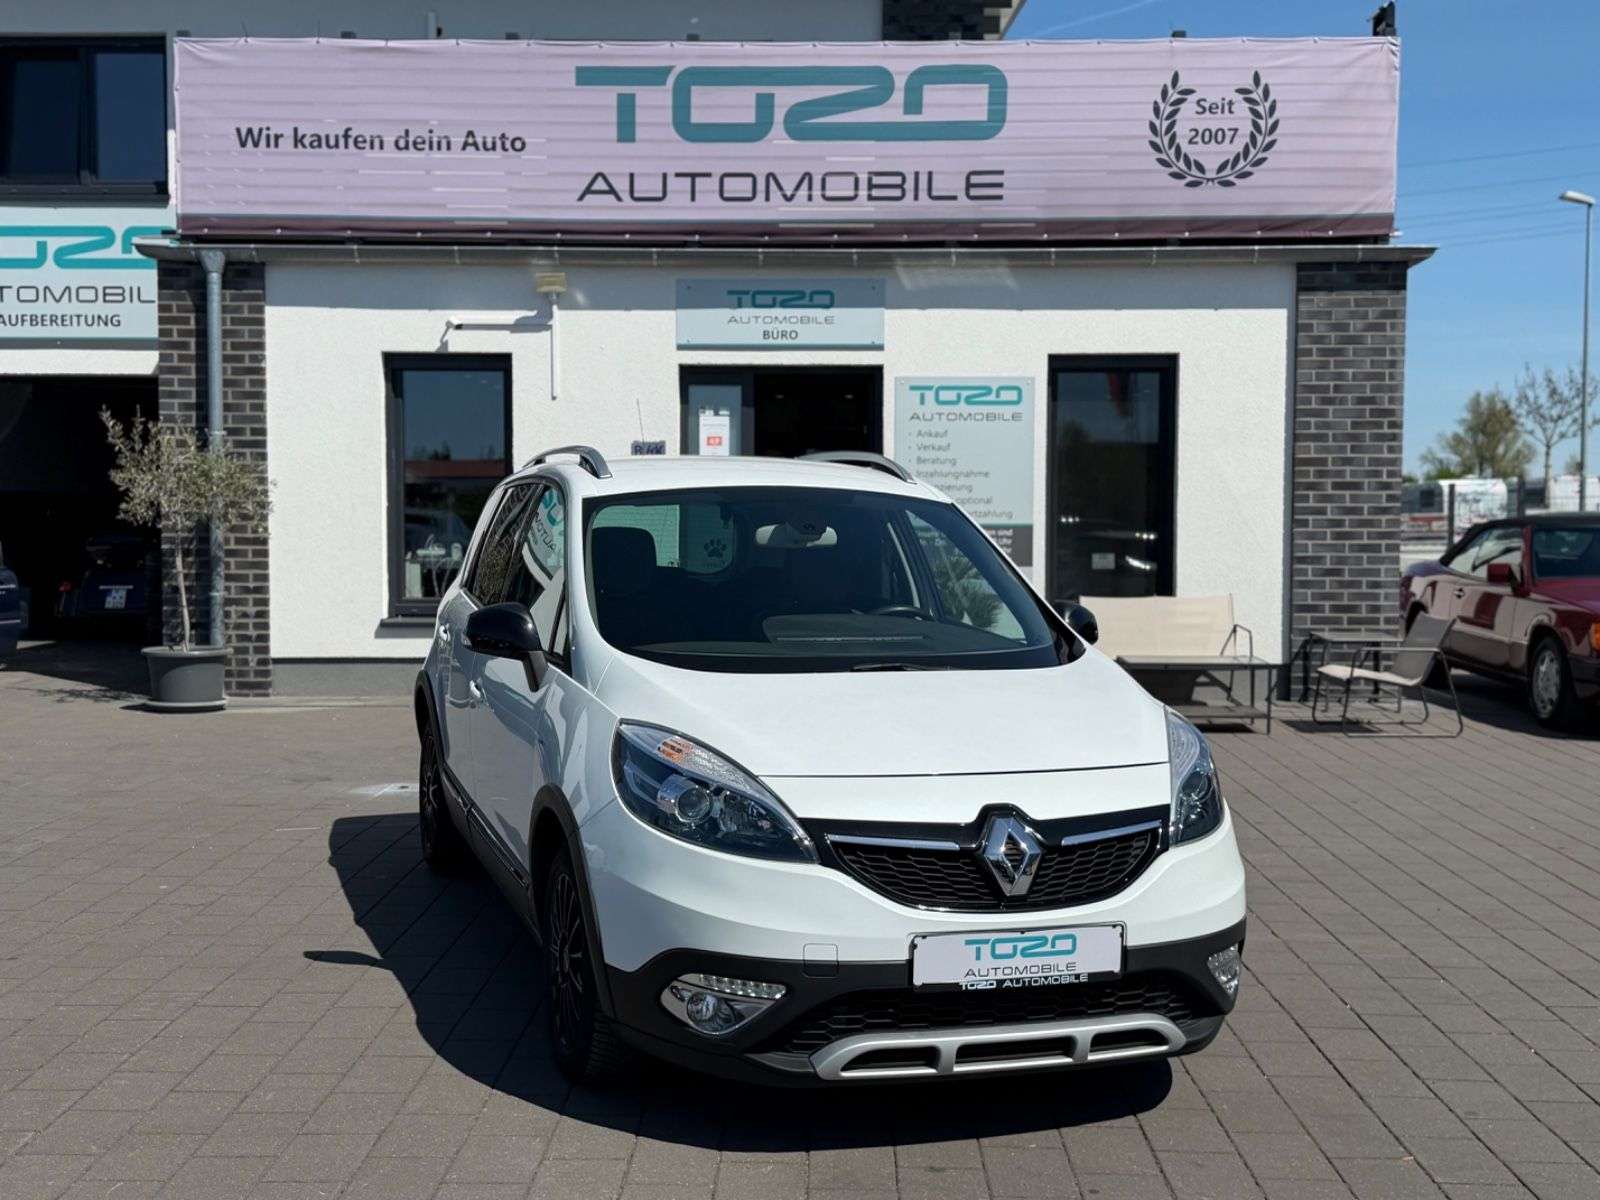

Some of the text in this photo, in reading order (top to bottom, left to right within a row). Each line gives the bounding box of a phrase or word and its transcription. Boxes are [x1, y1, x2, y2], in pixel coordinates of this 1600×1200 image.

[1195, 97, 1235, 115] Seit
[235, 126, 527, 152] Wir kaufen dein Auto
[1188, 128, 1239, 145] 2007
[577, 170, 1005, 202] AUTOMOBILE
[0, 285, 156, 304] TOMOBIL
[0, 314, 121, 327] AUFBEREITUNG
[727, 315, 835, 325] AUTOMOBILE
[762, 327, 799, 340] BÜRO
[909, 412, 1024, 422] AUTOMOBILE
[916, 429, 948, 438] Ankauf
[916, 442, 951, 451] Verkauf
[916, 456, 957, 466] Beratung
[964, 961, 1078, 978] AUTOMOBILE
[1002, 973, 1089, 988] AUTOMOBILE
